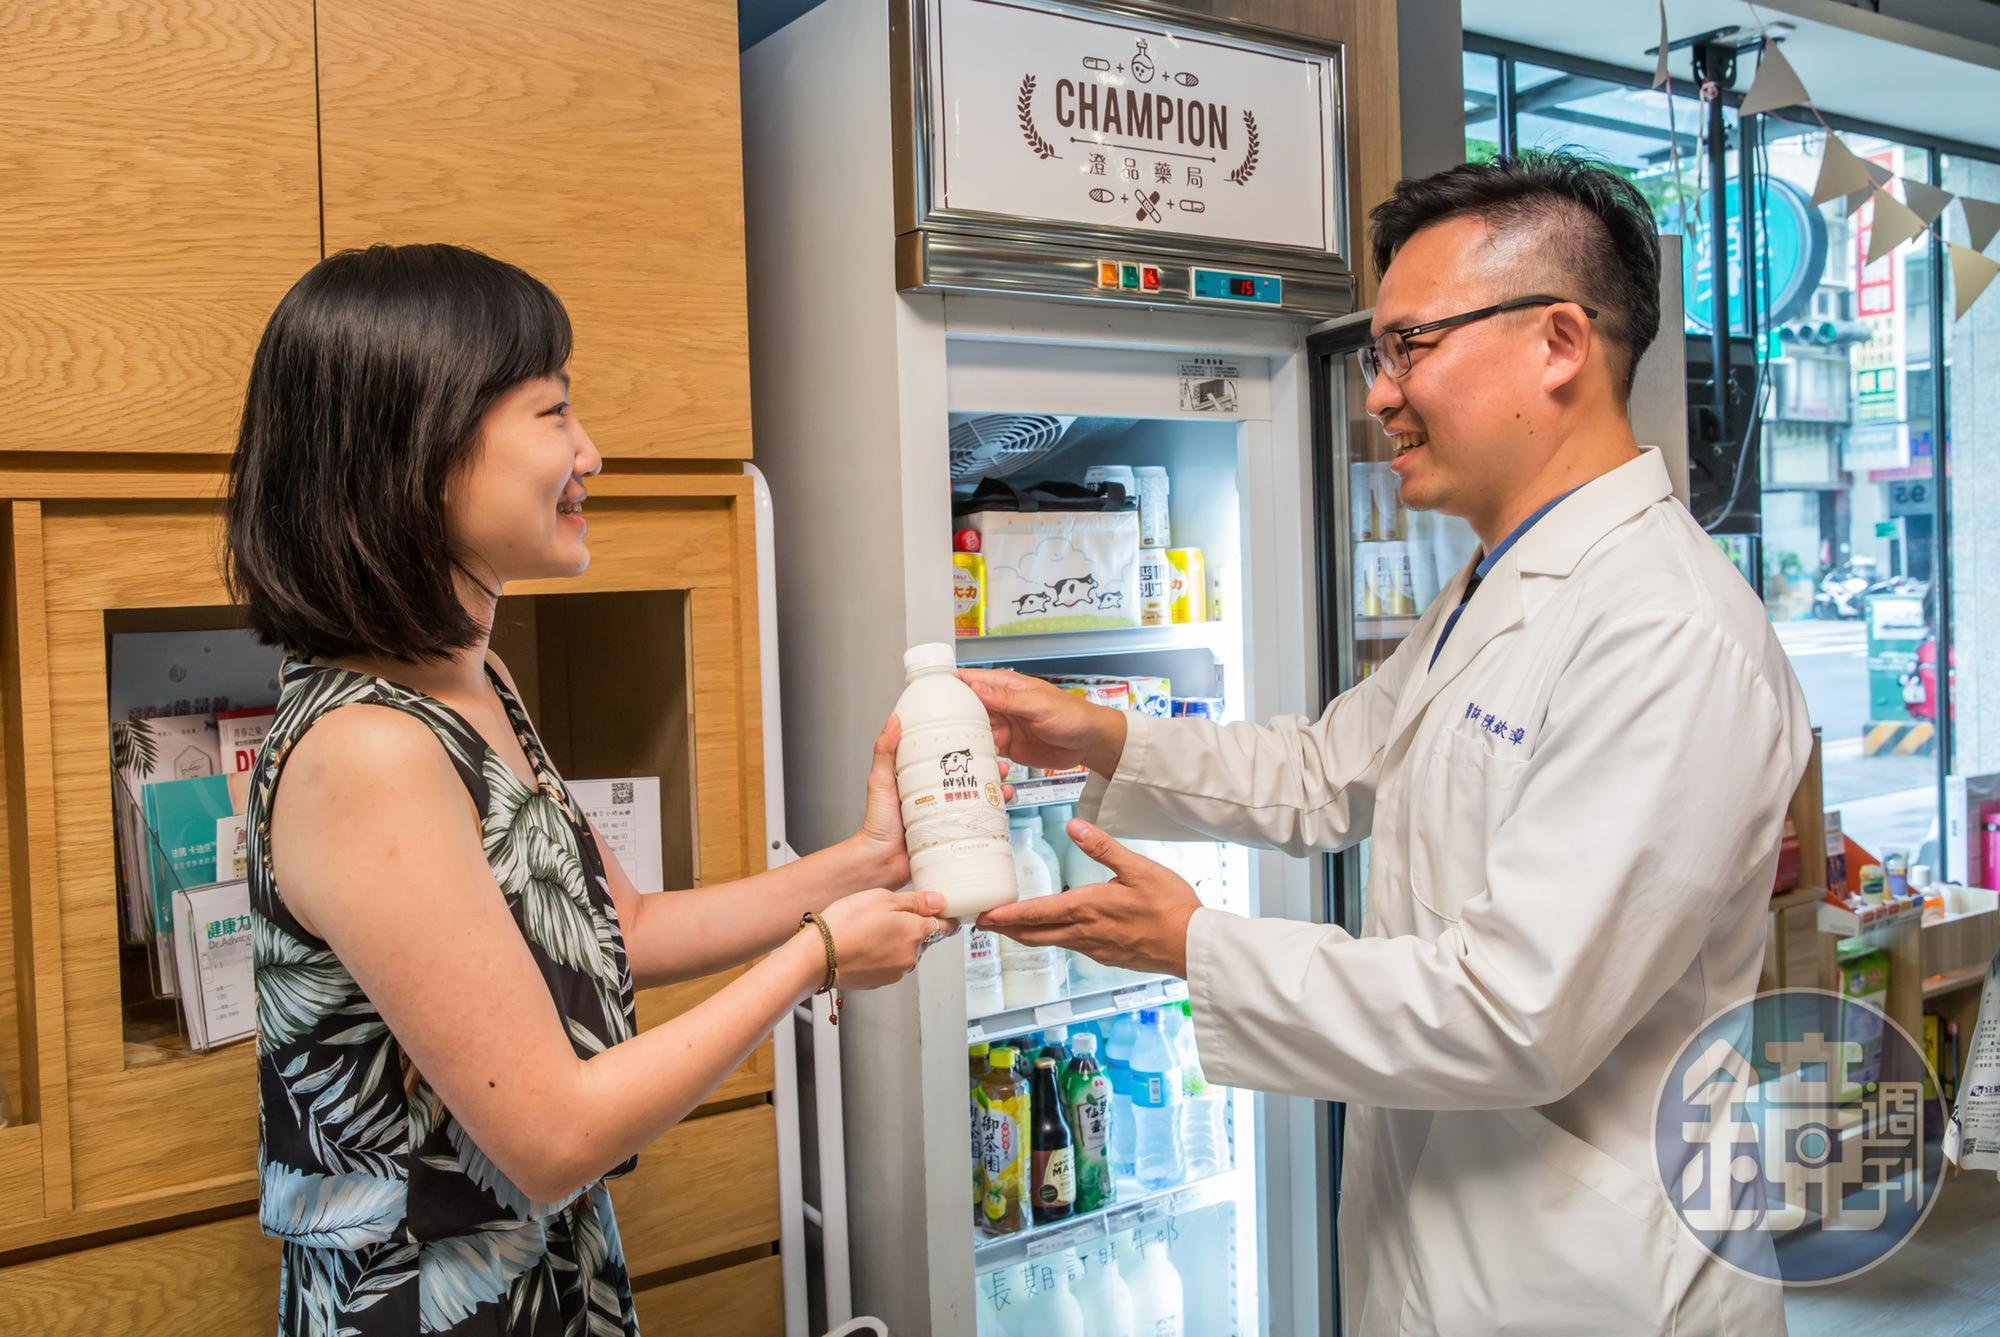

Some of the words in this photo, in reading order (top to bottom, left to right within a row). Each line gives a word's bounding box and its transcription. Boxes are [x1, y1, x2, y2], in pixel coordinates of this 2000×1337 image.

[1055, 78, 1228, 150] CHAMPION
[1087, 151, 1204, 189] 澄品藥局
[207, 915, 252, 940] 健康力
[981, 1115, 1000, 1173] 御茶園
